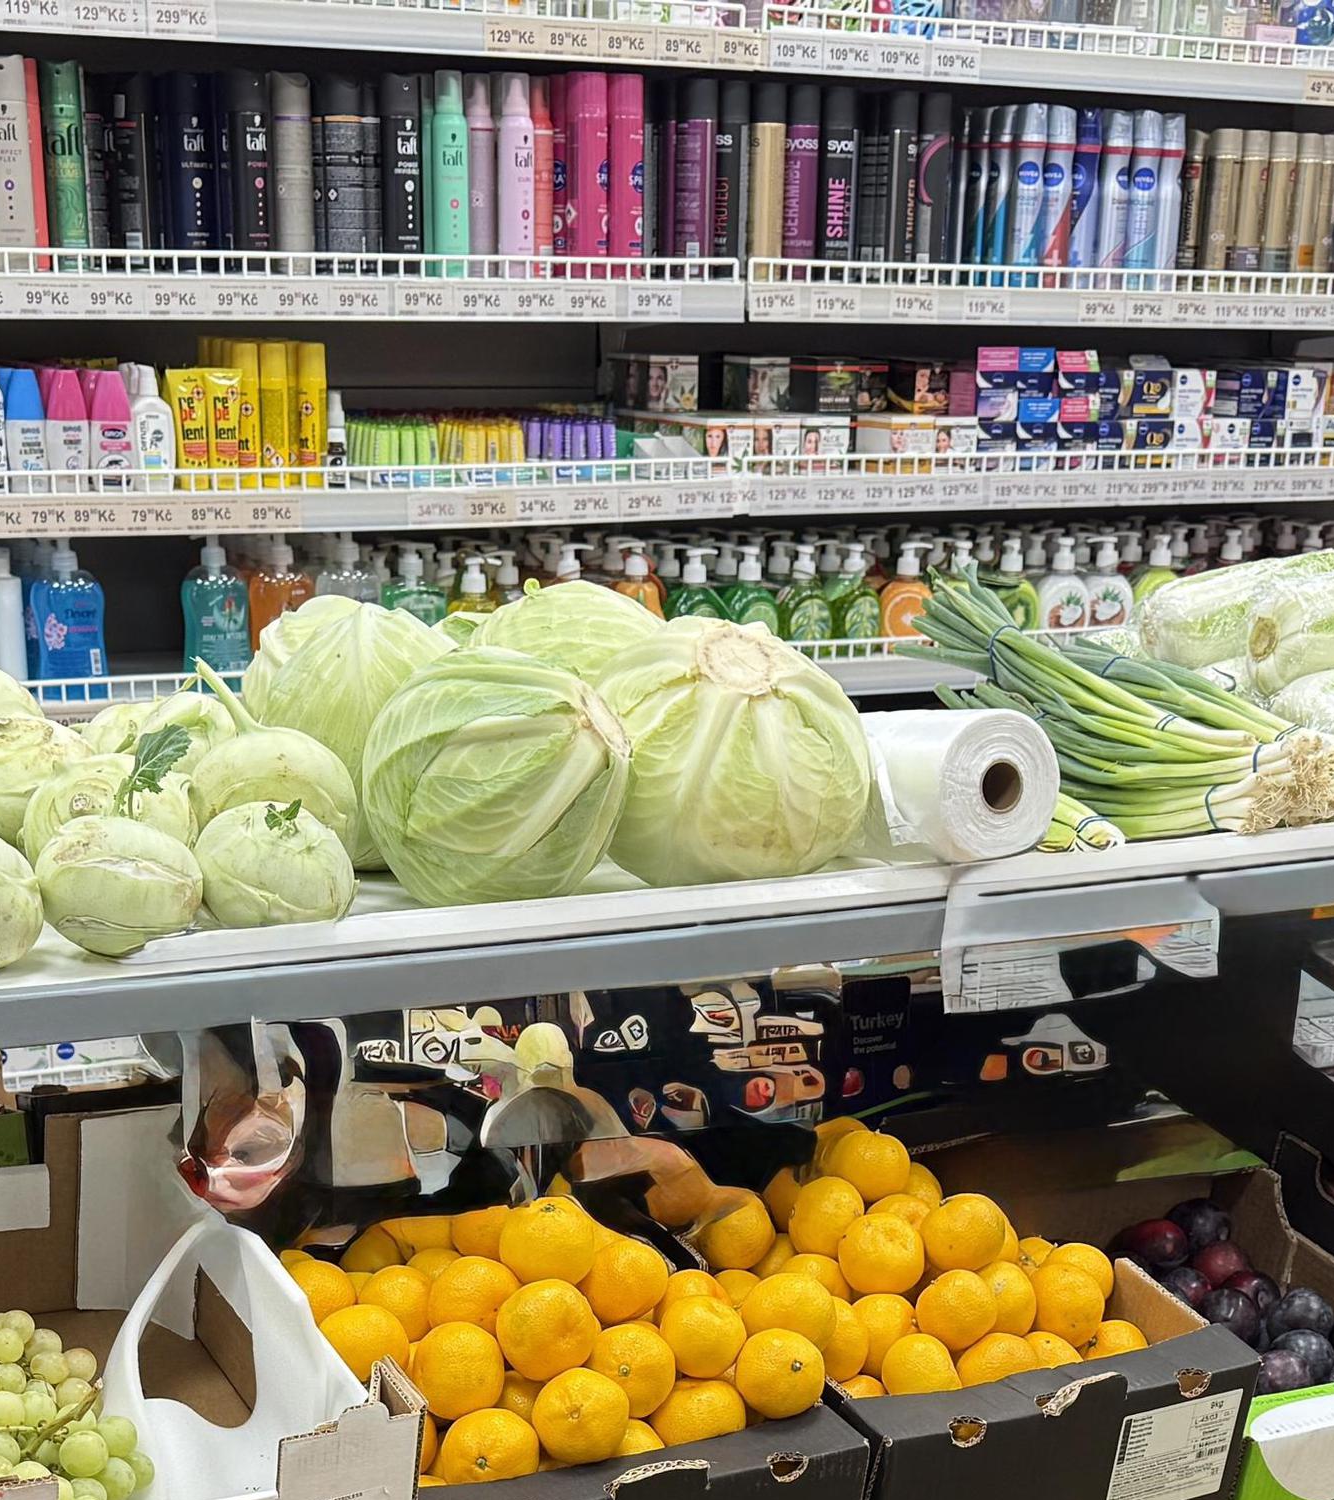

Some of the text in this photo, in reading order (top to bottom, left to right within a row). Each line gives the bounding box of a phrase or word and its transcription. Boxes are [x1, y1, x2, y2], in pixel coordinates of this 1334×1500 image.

[183, 133, 204, 152] taft
[443, 151, 463, 166] taft
[827, 177, 846, 238] SHINE
[850, 1010, 904, 1031] Turkey
